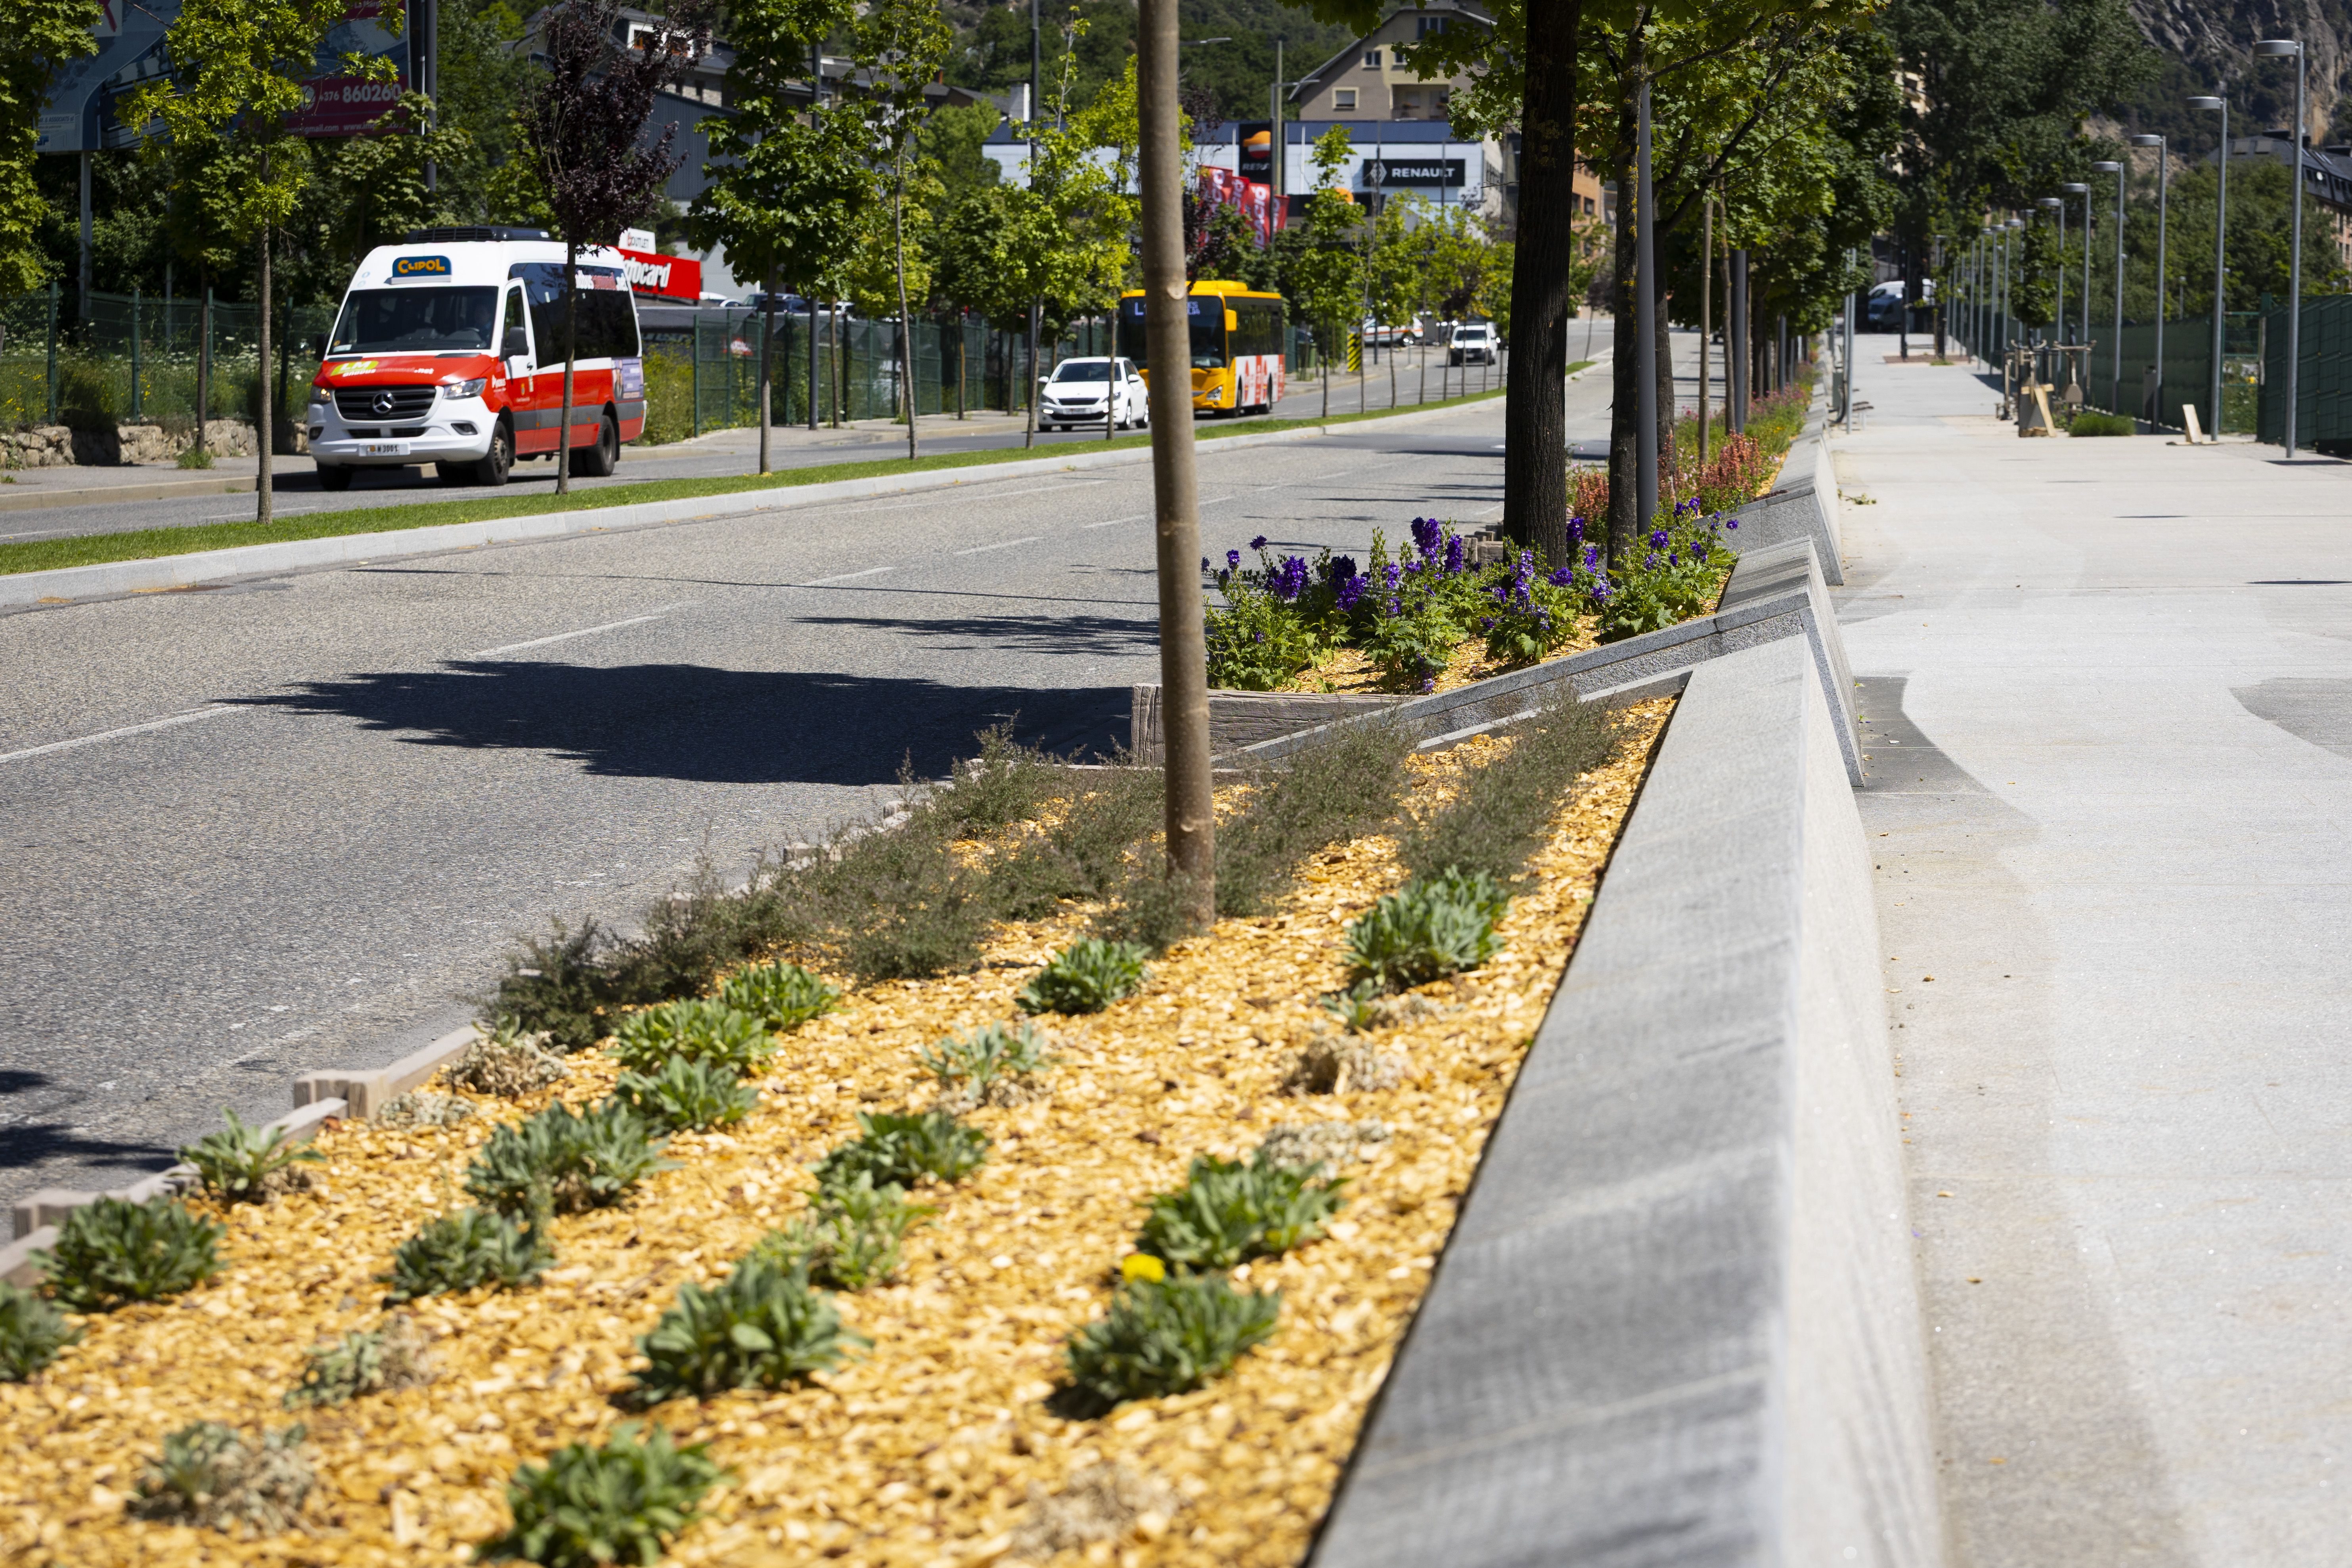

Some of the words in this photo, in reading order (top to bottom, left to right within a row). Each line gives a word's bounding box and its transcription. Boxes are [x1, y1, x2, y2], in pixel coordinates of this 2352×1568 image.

[343, 83, 402, 103] 860260
[1391, 167, 1456, 178] RENAULT
[341, 360, 372, 371] LM
